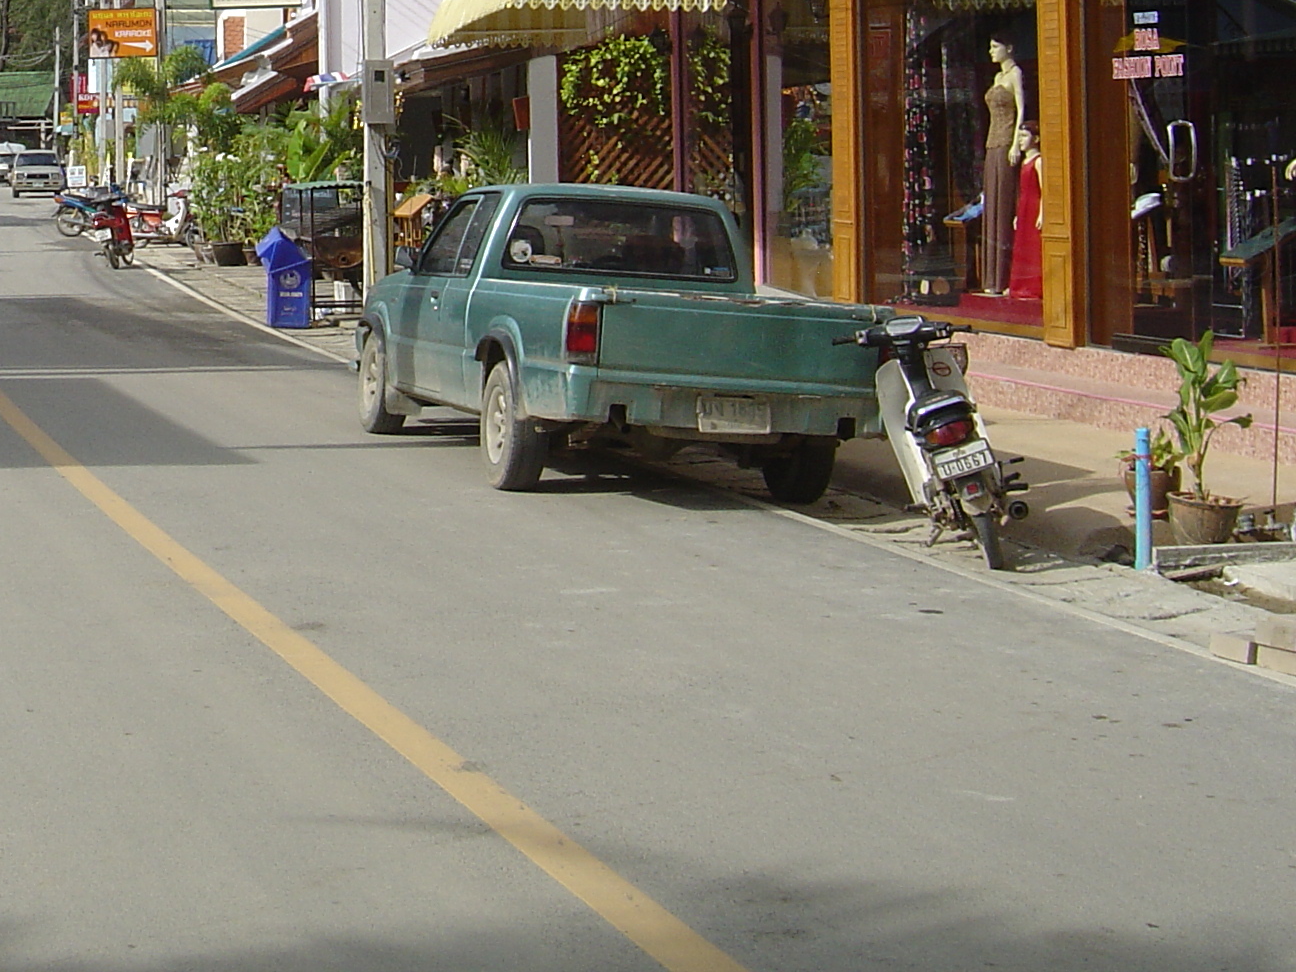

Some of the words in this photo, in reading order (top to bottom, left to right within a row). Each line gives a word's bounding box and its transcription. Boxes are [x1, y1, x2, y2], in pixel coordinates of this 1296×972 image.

[106, 19, 152, 28] NARUMON
[1133, 28, 1160, 51] ROSA
[1112, 56, 1151, 80] FASHION
[1154, 54, 1184, 77] POINT
